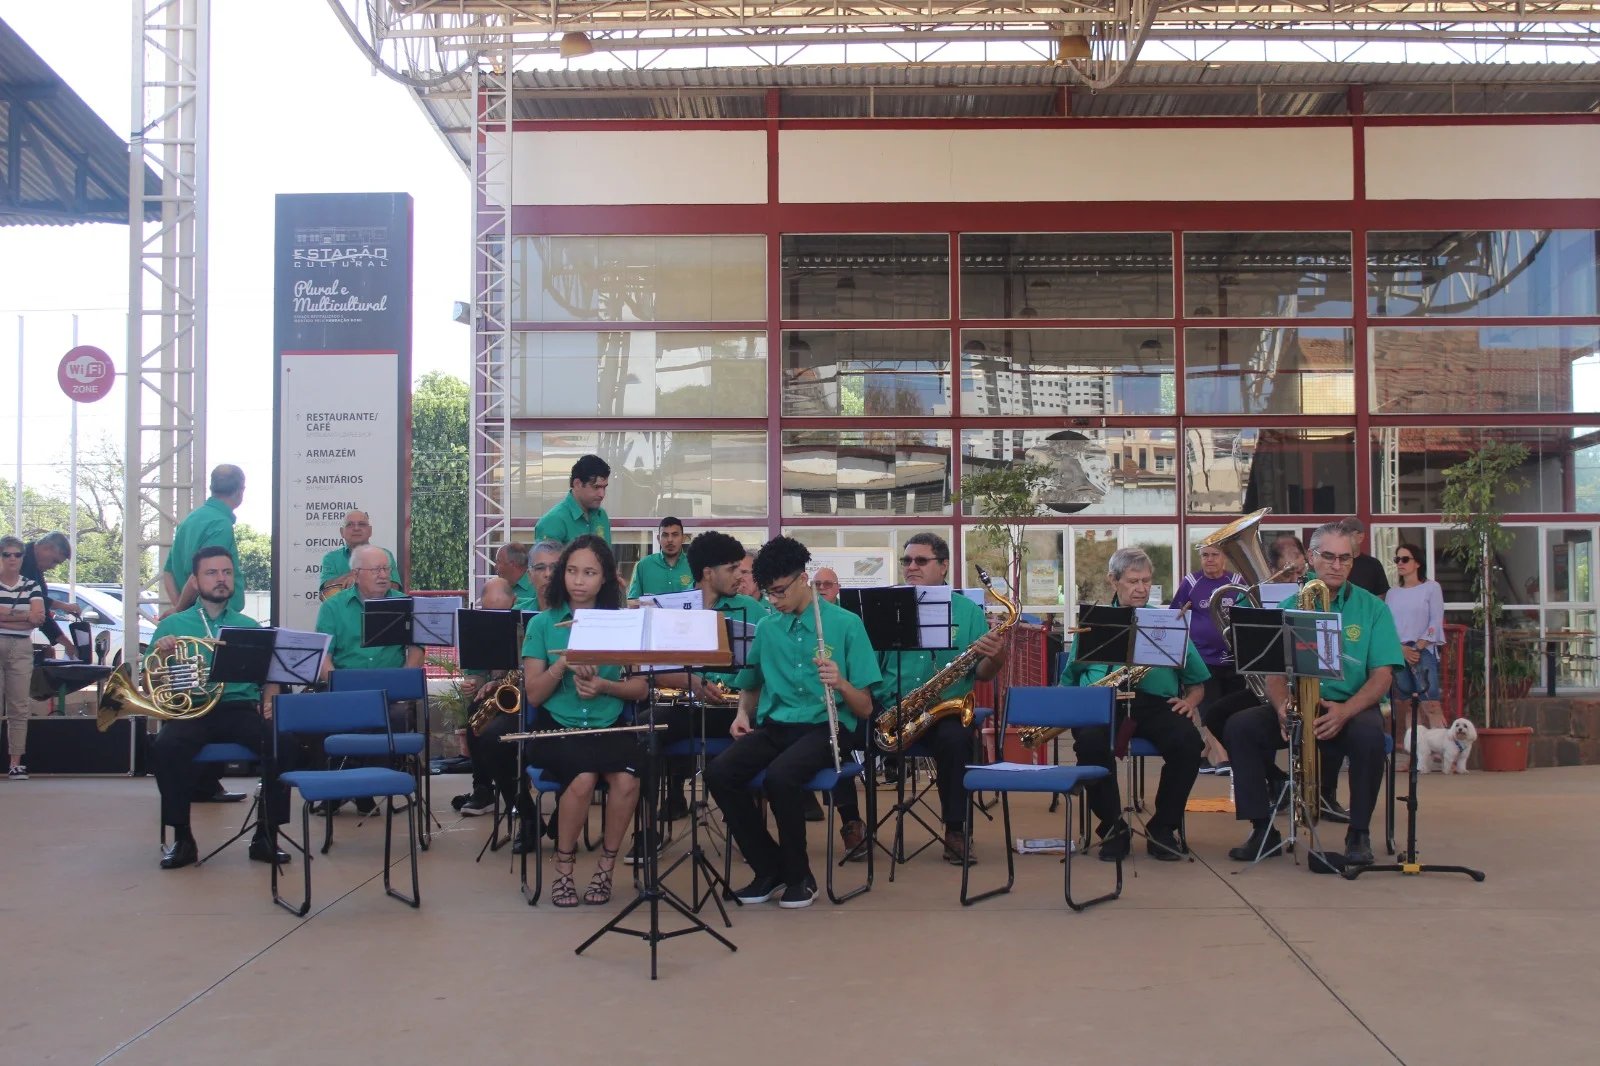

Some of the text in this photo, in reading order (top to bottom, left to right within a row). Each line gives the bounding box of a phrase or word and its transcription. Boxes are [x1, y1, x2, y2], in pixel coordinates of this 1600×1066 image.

[293, 245, 388, 262] ESTAÇÃO
[294, 280, 349, 298] Plural e
[293, 295, 388, 312] Multicultural
[72, 385, 99, 393] ZONE
[306, 412, 378, 421] RESTAURANTE/
[306, 421, 331, 431] CAFÉ
[306, 447, 356, 458] ARMAZÉM
[306, 474, 363, 484] SANITÁRIOS
[306, 501, 358, 510] MEMORIAL
[306, 512, 320, 520] DA
